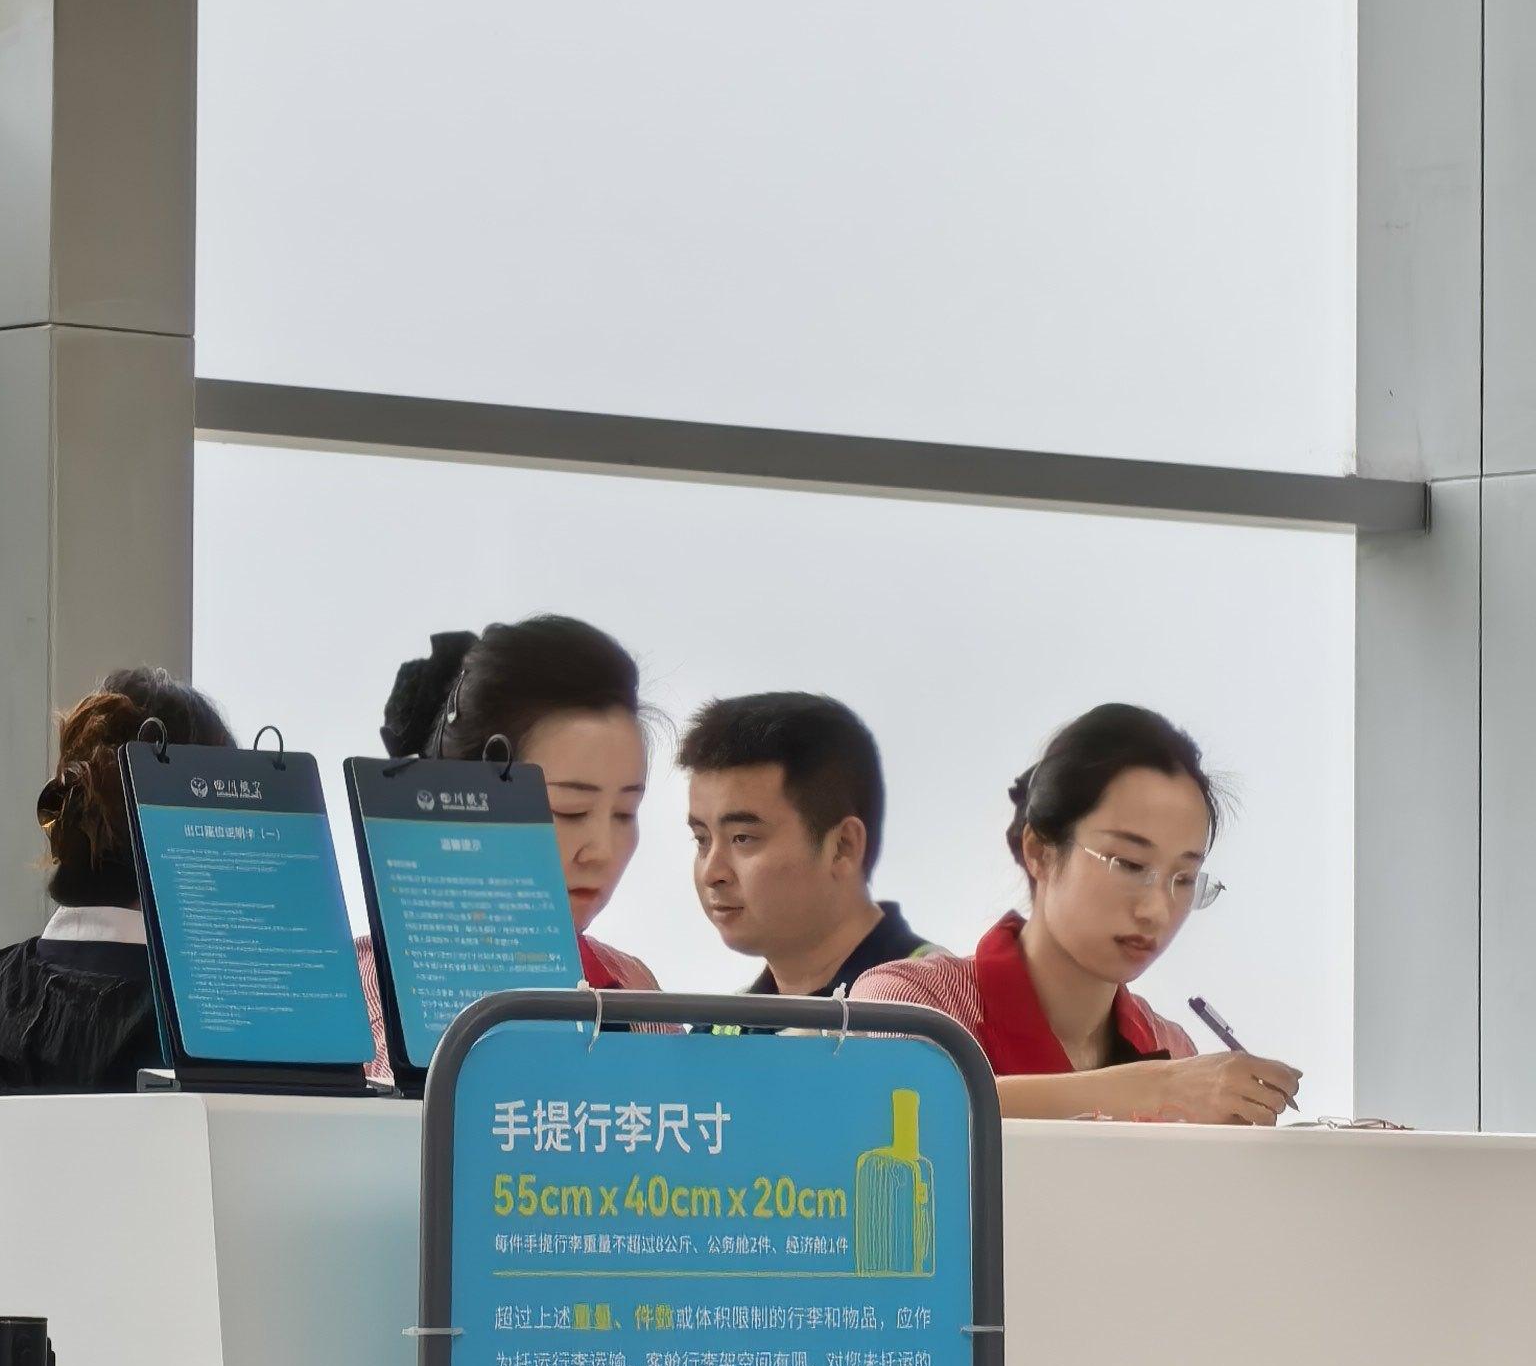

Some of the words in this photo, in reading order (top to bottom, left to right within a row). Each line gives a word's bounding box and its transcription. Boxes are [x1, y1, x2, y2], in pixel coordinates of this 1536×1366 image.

[492, 1099, 732, 1155] 手提行李尺寸
[493, 1173, 593, 1218] 55cm
[624, 1174, 721, 1218] 40cm
[752, 1175, 848, 1219] 20cm
